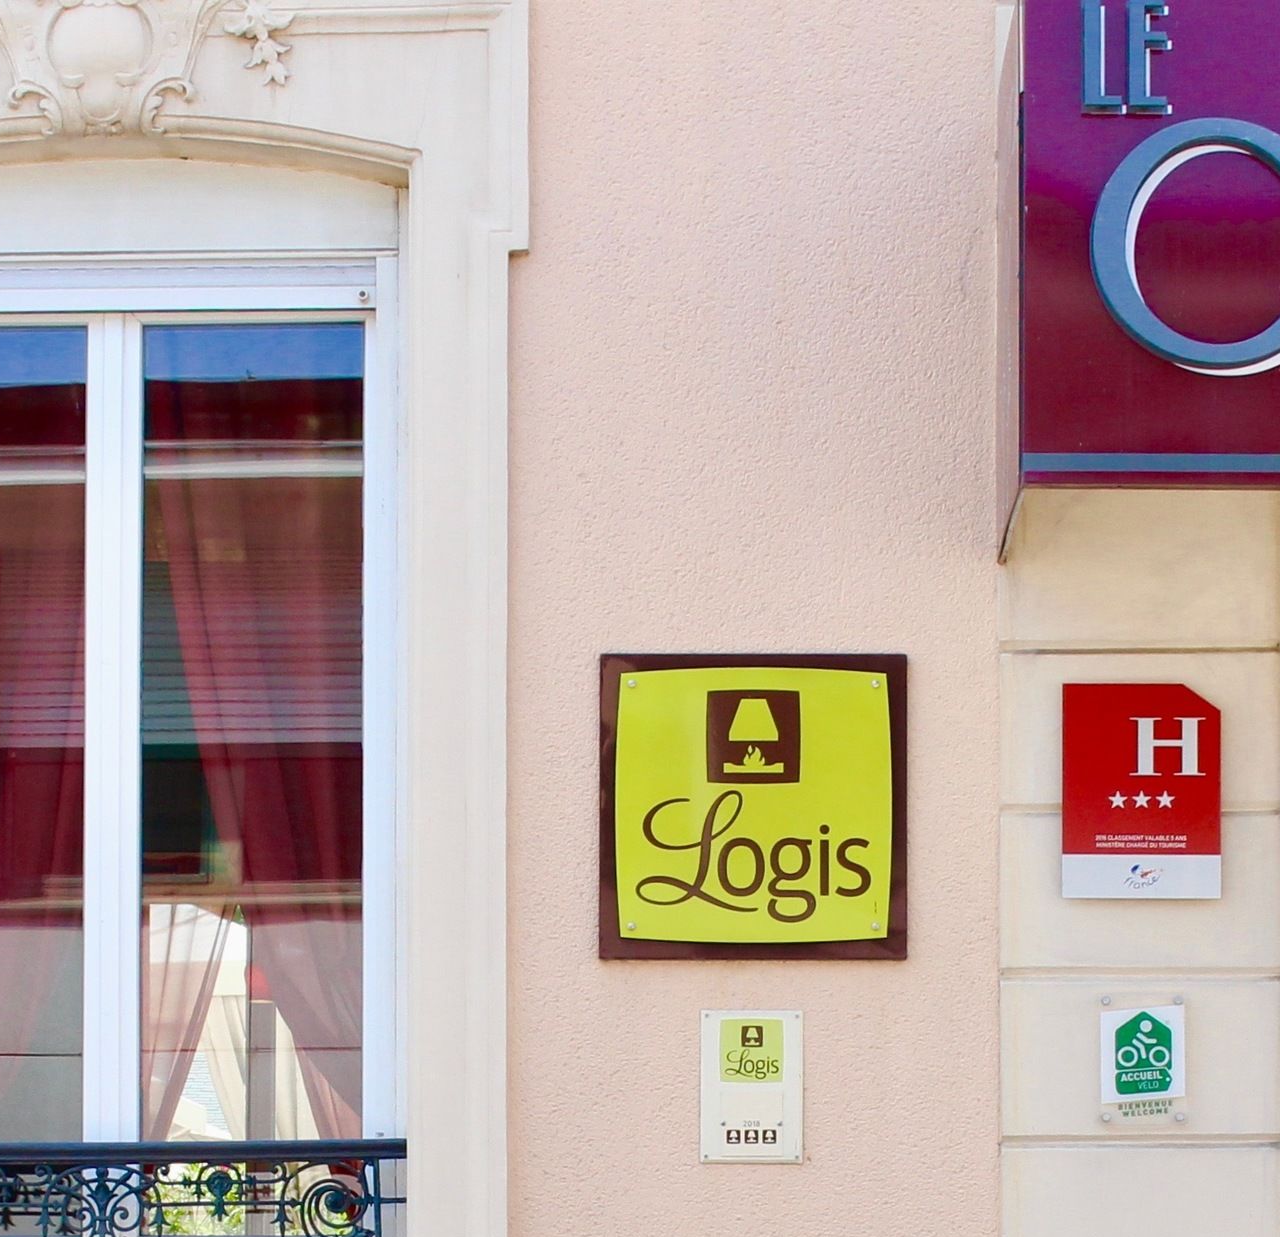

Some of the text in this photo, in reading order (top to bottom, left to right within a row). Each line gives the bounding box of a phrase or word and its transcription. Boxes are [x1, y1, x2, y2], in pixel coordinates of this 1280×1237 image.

[1082, 0, 1172, 115] LE
[1129, 716, 1207, 777] H
[635, 789, 872, 923] Logis
[724, 1049, 780, 1080] Logis
[1120, 1071, 1163, 1082] ACCUEIL
[1118, 1100, 1172, 1110] BIENVENUE
[1122, 1108, 1169, 1117] WELCOME
